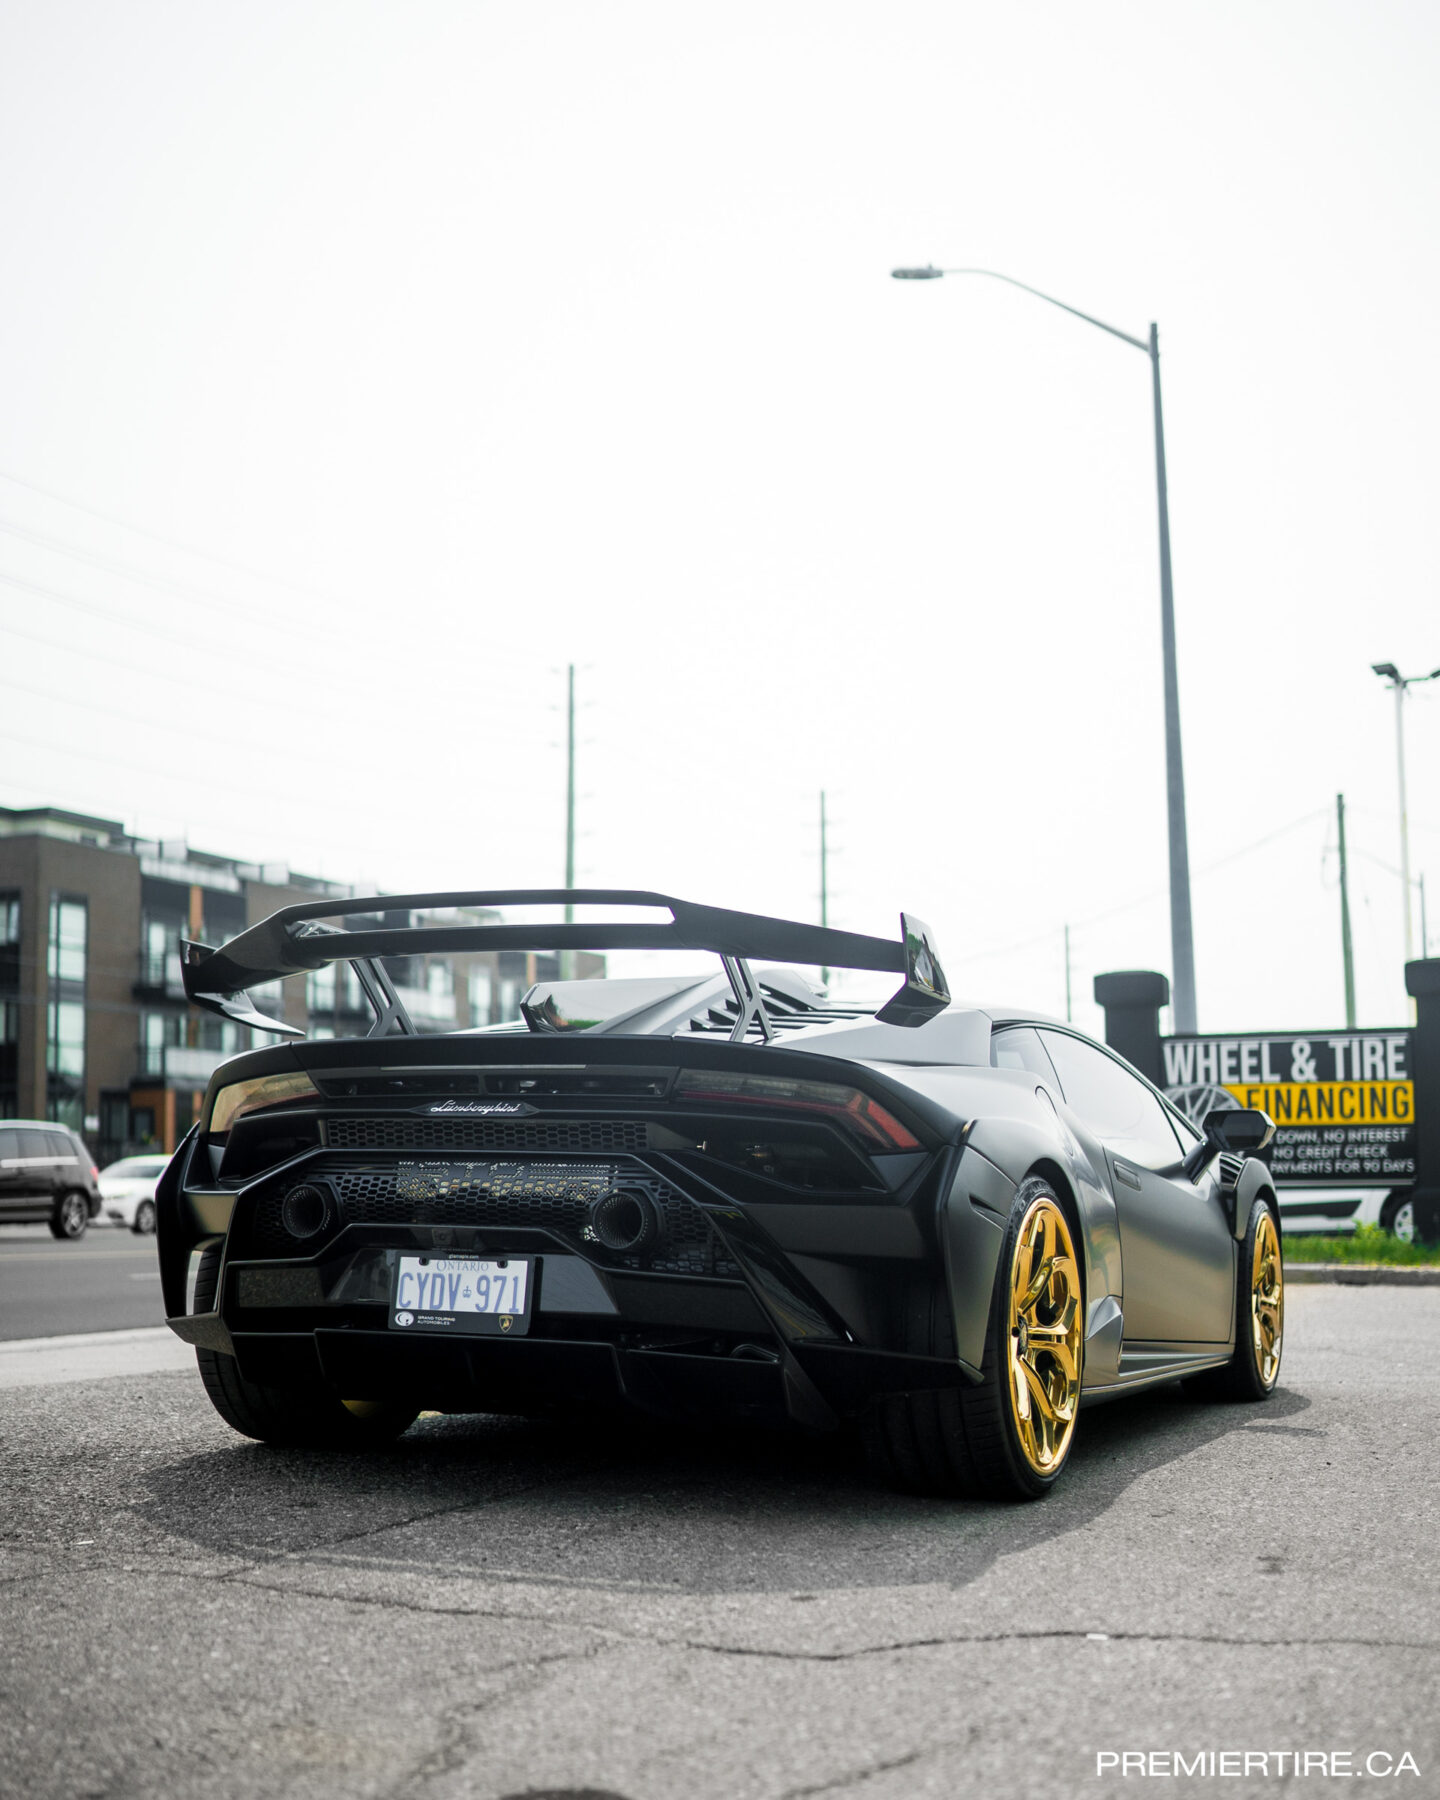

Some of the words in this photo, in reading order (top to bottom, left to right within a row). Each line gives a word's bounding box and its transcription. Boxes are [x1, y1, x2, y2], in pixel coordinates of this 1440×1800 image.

[1163, 1040, 1281, 1085] WHEEL
[1290, 1037, 1318, 1082] &
[1328, 1037, 1408, 1081] TIRE
[430, 1099, 521, 1115] Lamborghini
[1246, 1086, 1409, 1120] FINANCING
[1276, 1130, 1321, 1144] DOWN,
[1323, 1129, 1345, 1142] NO
[1348, 1128, 1407, 1142] INTEREST
[1272, 1146, 1294, 1159] NO
[1297, 1145, 1341, 1158] CREDIT
[1344, 1144, 1389, 1158] CHECK
[1270, 1160, 1333, 1174] PAYMENTS
[1335, 1159, 1361, 1173] FOR
[1363, 1159, 1380, 1172] 90
[1383, 1158, 1415, 1172] DAYS
[436, 1260, 489, 1273] ONTARIO
[399, 1273, 461, 1310] CYDV
[475, 1275, 519, 1312] 971
